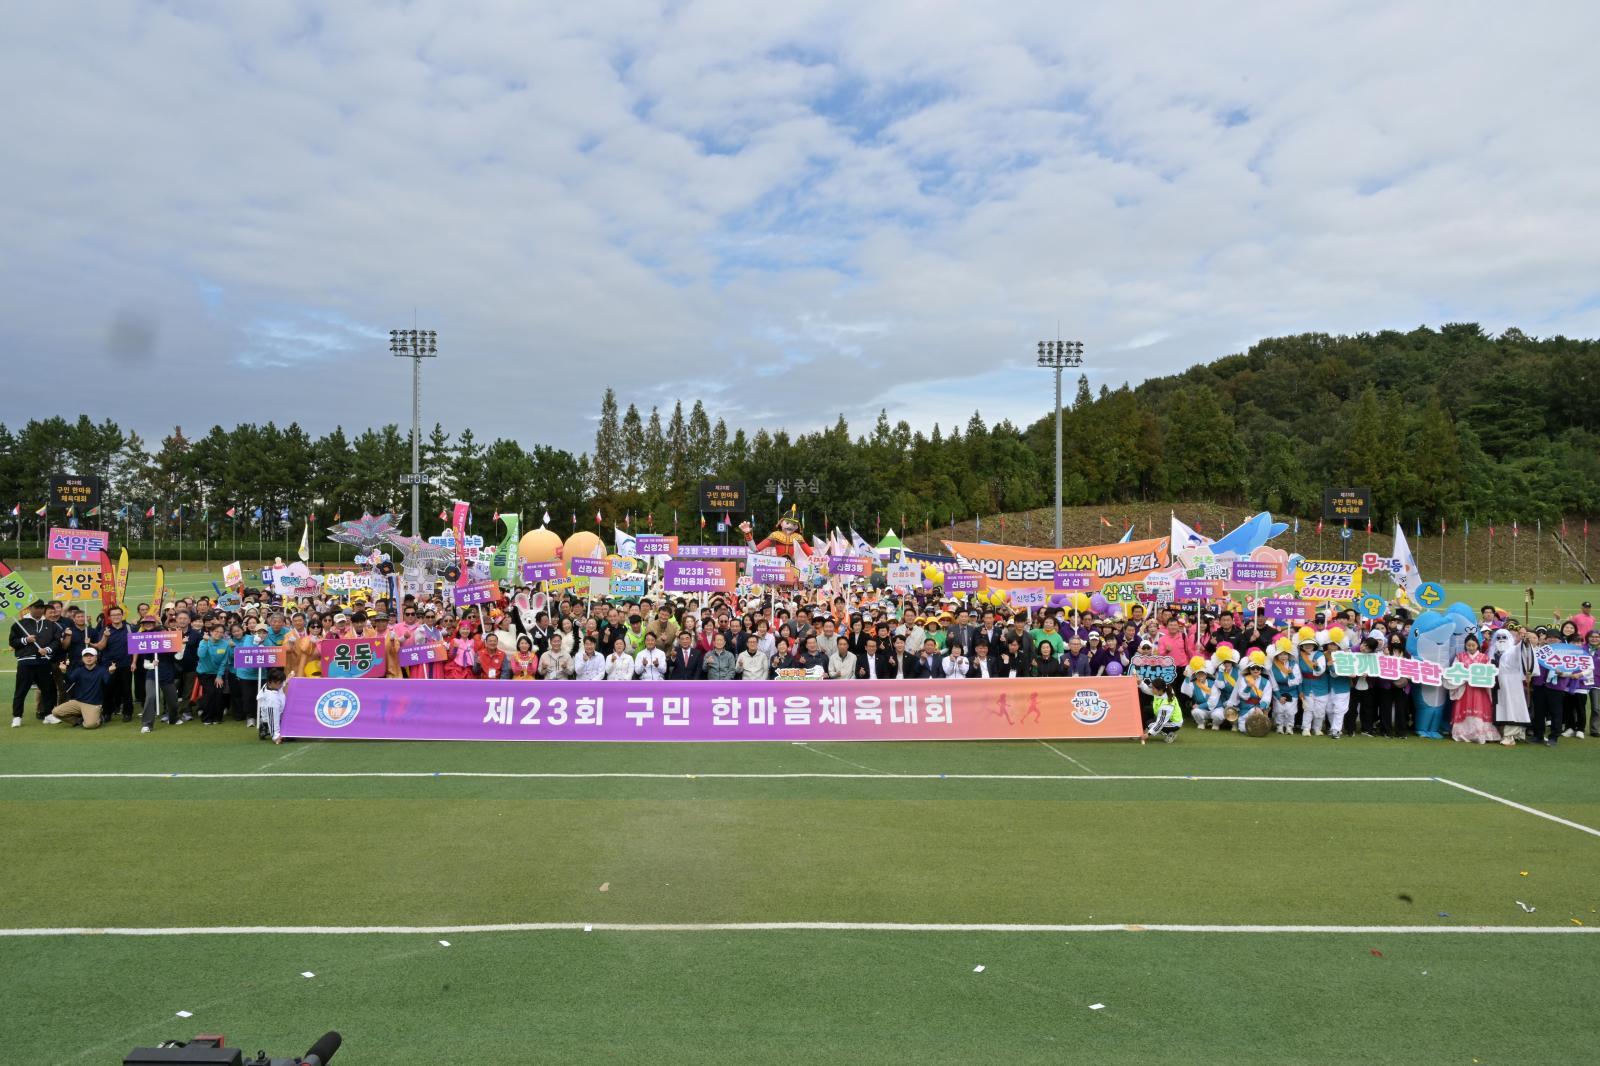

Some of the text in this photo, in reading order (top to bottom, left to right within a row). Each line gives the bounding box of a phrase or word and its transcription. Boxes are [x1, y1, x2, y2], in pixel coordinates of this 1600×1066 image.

[720, 491, 740, 499] 한마음
[54, 535, 104, 552] 선암동
[643, 543, 670, 552] 신정2동
[702, 547, 718, 555] 구민
[836, 563, 864, 573] 신정3동
[1006, 558, 1056, 581] 심장은
[1129, 551, 1160, 574] 뛴다.
[1301, 561, 1357, 574] 아자아자
[1362, 554, 1403, 573] 무거동
[578, 564, 604, 575] 신정4동
[678, 567, 722, 576] 제23회 구민
[673, 577, 726, 586] 한마음체육대회
[760, 573, 785, 582] 신정1동
[1062, 578, 1090, 587] 삼산동
[1304, 574, 1352, 587] 수암동
[951, 580, 978, 589] 신정5동
[1184, 587, 1213, 596] 무거동
[1301, 587, 1354, 599] 화이팅!!
[1420, 585, 1441, 605] 수
[1016, 592, 1044, 603] 신정5동
[1273, 606, 1305, 616] 수암동
[1364, 598, 1382, 616] 암
[138, 639, 172, 650] 선암동
[244, 654, 277, 665] 대현동
[335, 643, 373, 672] 옥동
[1546, 654, 1591, 670] 수암동
[1335, 653, 1497, 685] 함께 행복한 수암
[483, 694, 953, 726] 제23회 구민 한마음체육대회
